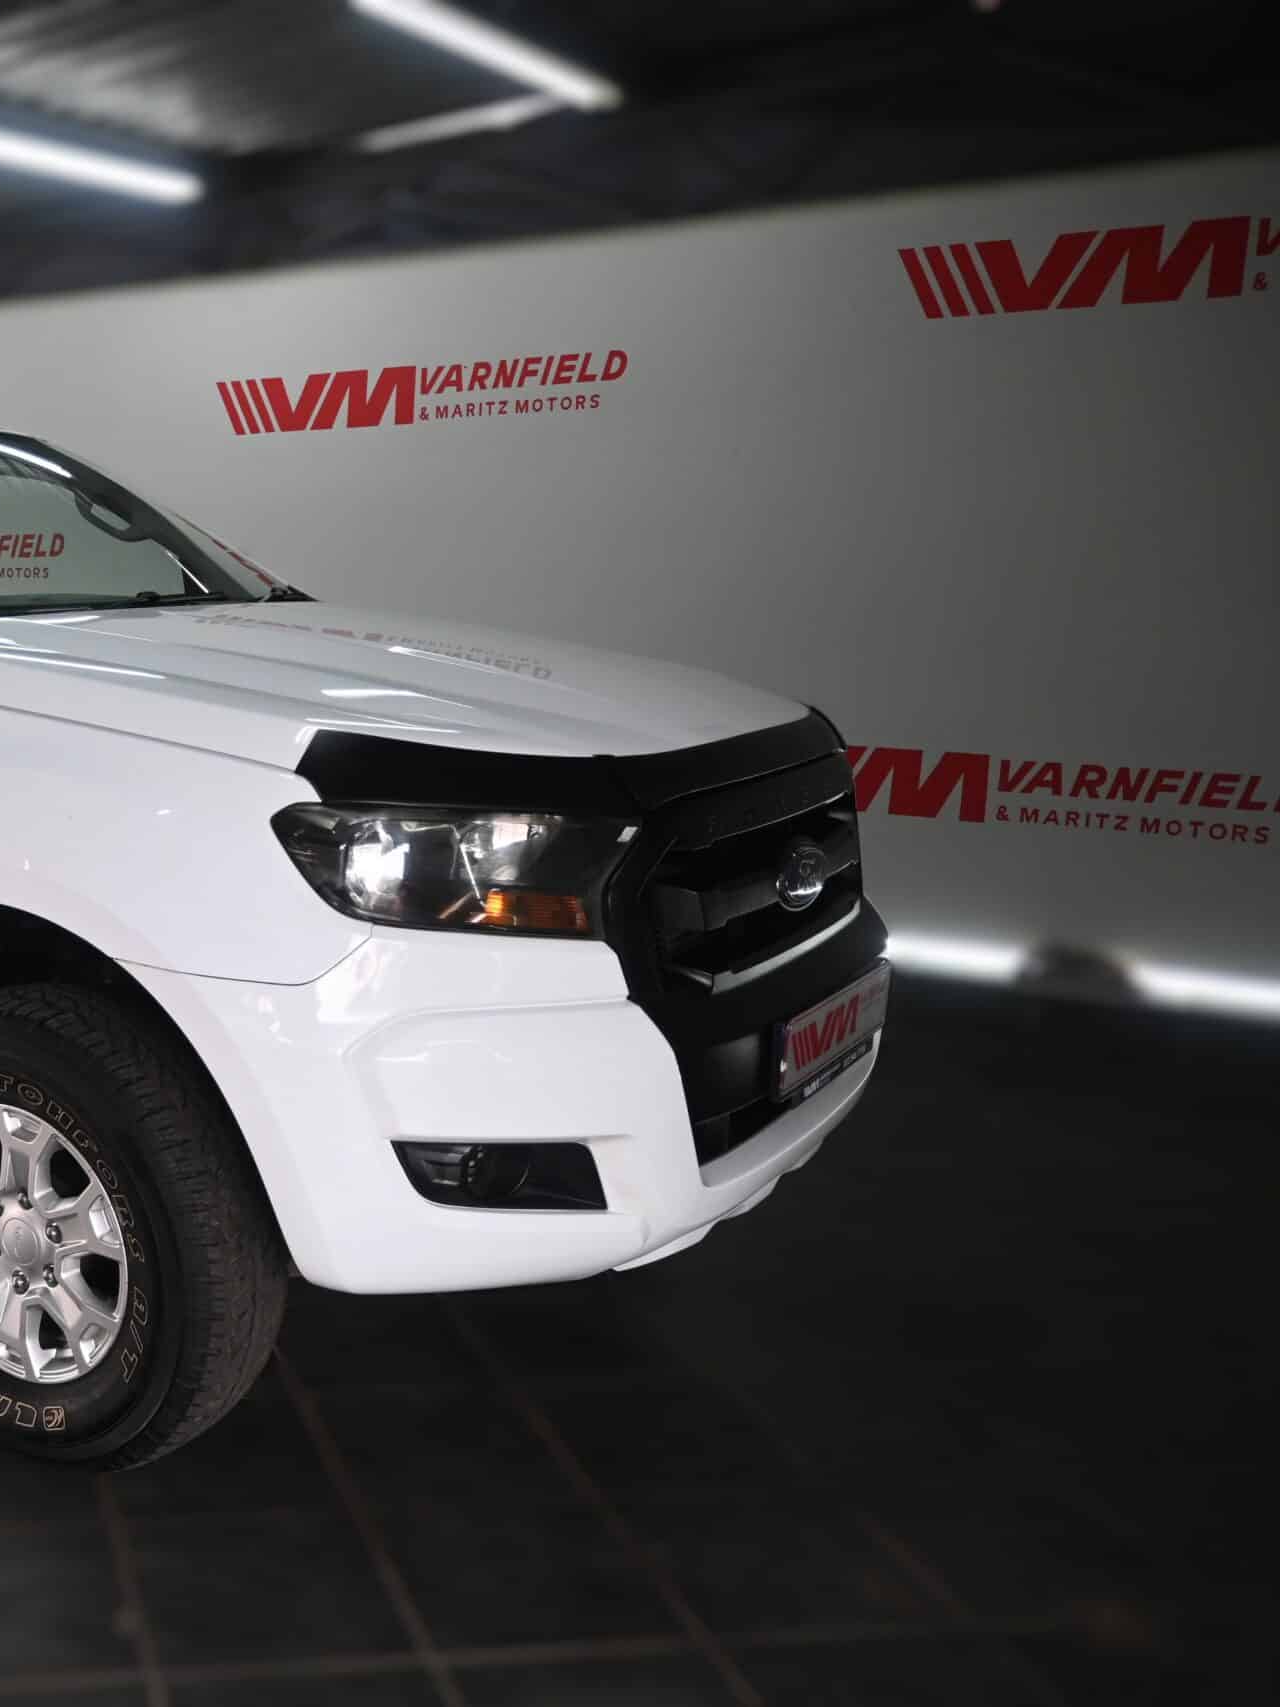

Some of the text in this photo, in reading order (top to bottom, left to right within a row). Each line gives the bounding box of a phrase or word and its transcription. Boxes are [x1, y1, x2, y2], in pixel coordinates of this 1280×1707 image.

[420, 349, 628, 395] VARNFIELD
[419, 394, 601, 421] & MARITZ MOTORS
[997, 759, 1280, 813] VARNFIEL
[995, 805, 1271, 845] & MARITZ MOTORS
